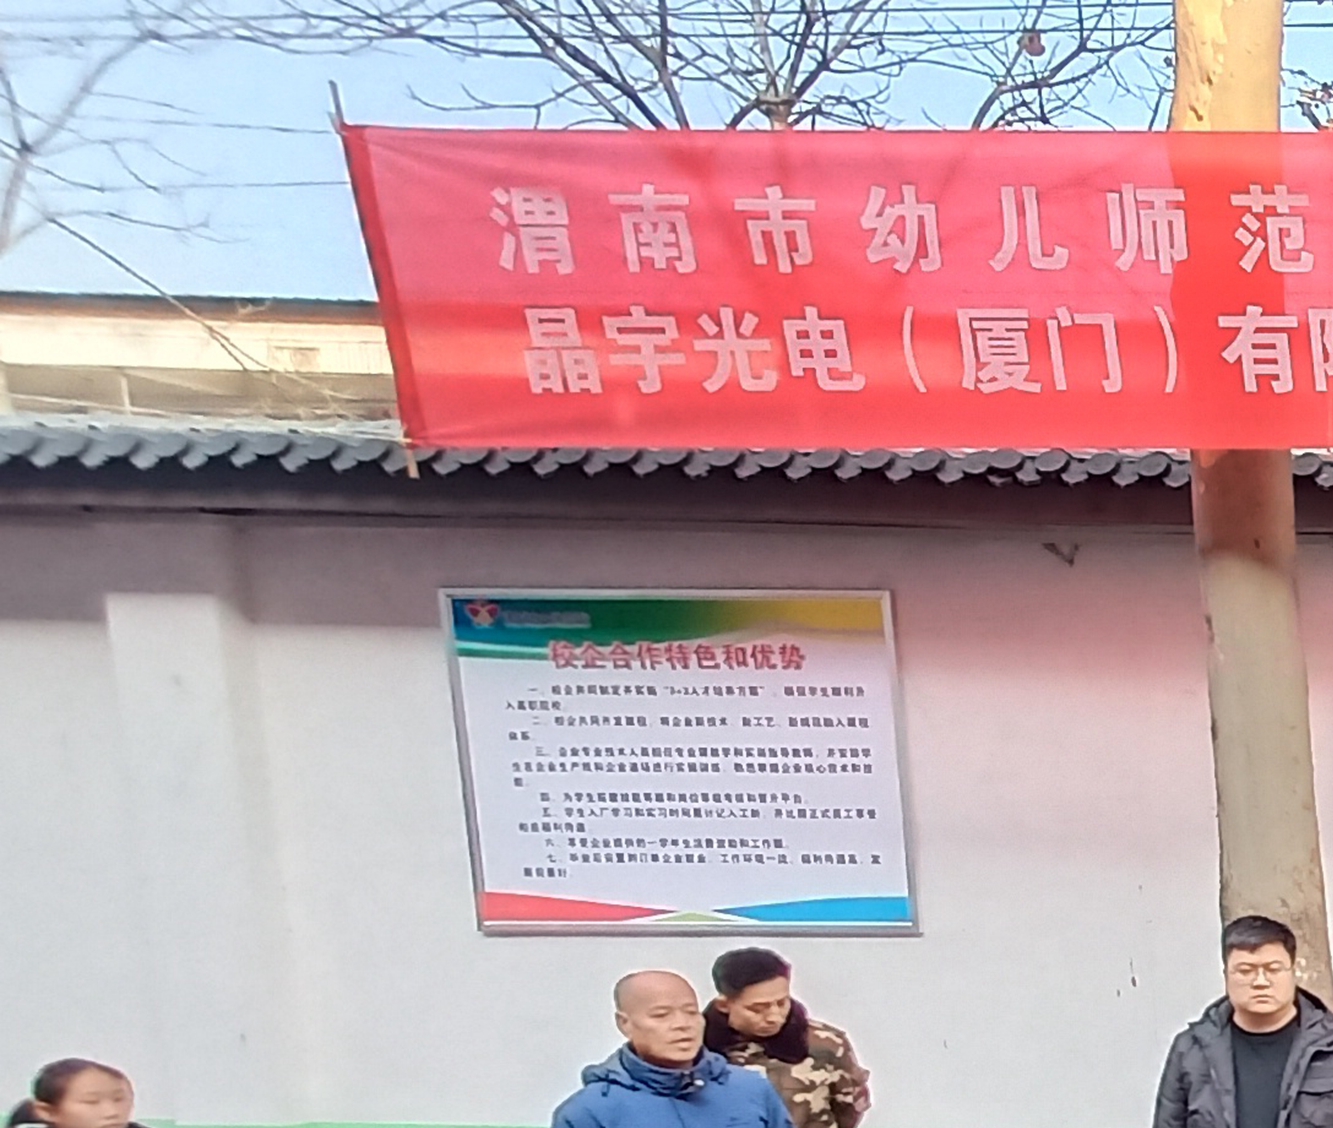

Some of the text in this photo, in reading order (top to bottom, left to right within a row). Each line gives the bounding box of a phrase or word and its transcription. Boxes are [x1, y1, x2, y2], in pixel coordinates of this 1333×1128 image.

[548, 640, 806, 673] 校企合作特色和优势
